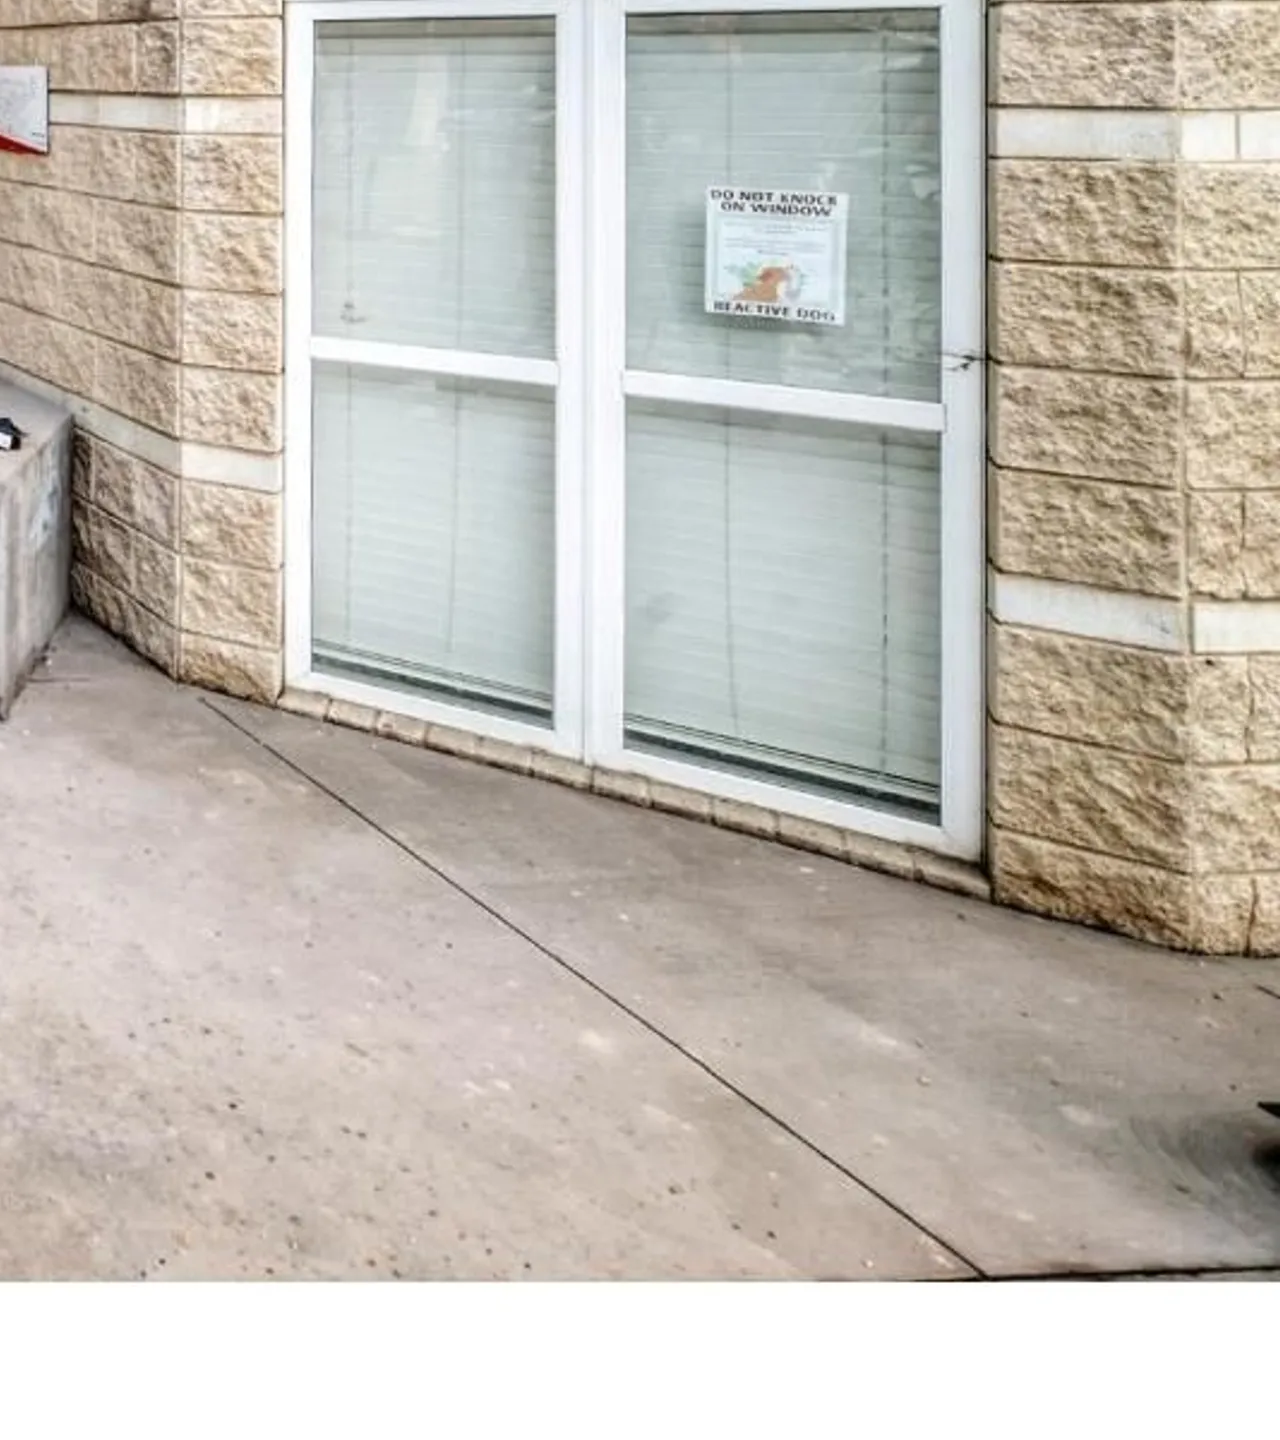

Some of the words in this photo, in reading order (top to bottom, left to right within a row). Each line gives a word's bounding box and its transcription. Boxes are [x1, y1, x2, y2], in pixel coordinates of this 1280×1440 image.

[710, 189, 735, 201] DO
[740, 191, 775, 203] NOT
[720, 201, 745, 212] ON
[751, 203, 832, 217] WINDOW
